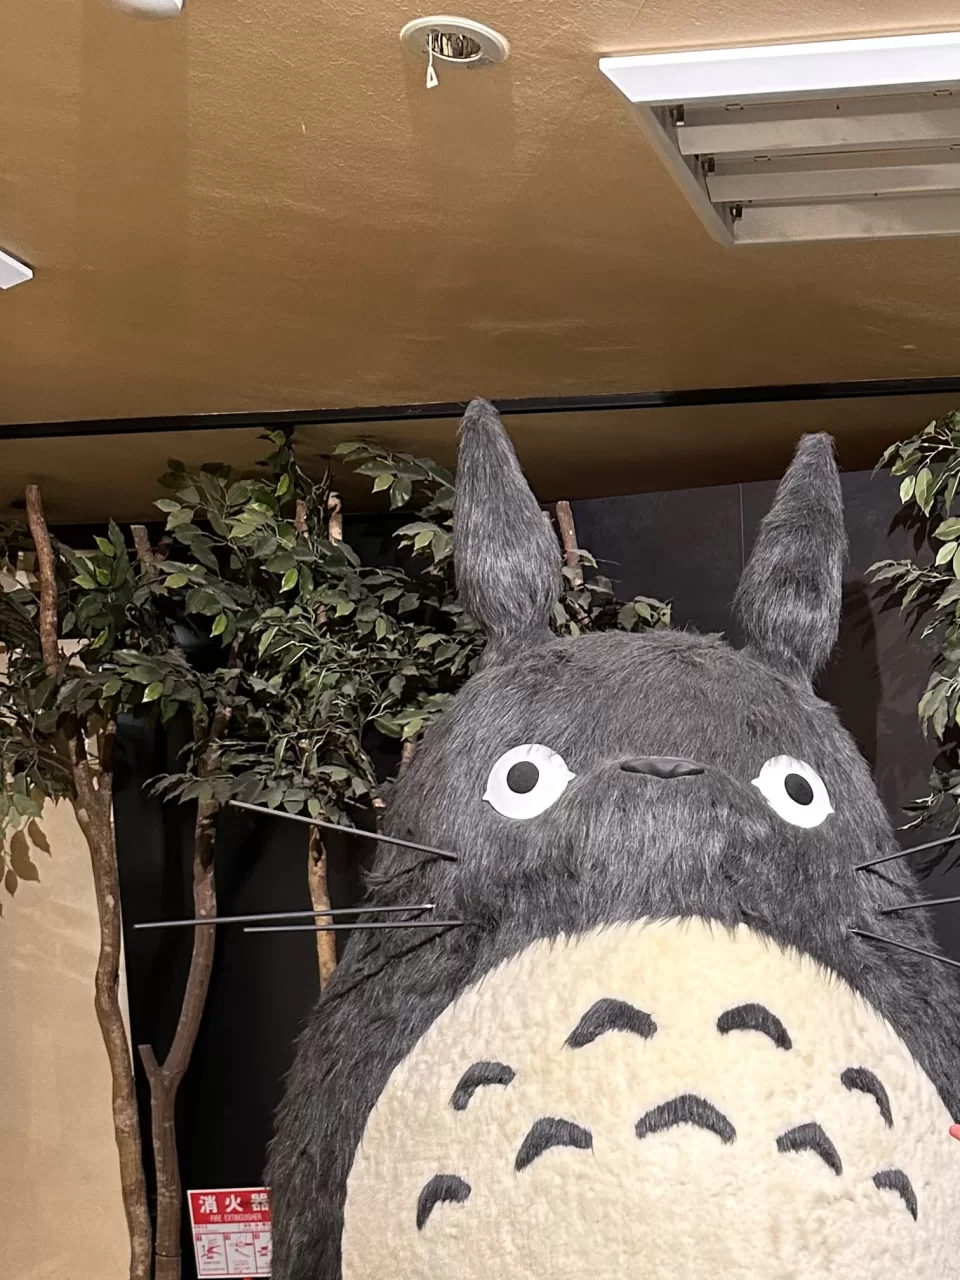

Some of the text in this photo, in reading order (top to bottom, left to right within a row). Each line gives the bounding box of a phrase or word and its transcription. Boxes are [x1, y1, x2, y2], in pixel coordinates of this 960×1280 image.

[198, 1192, 270, 1214] 消火器
[210, 1212, 263, 1223] FIRE EXTINGUISHER
